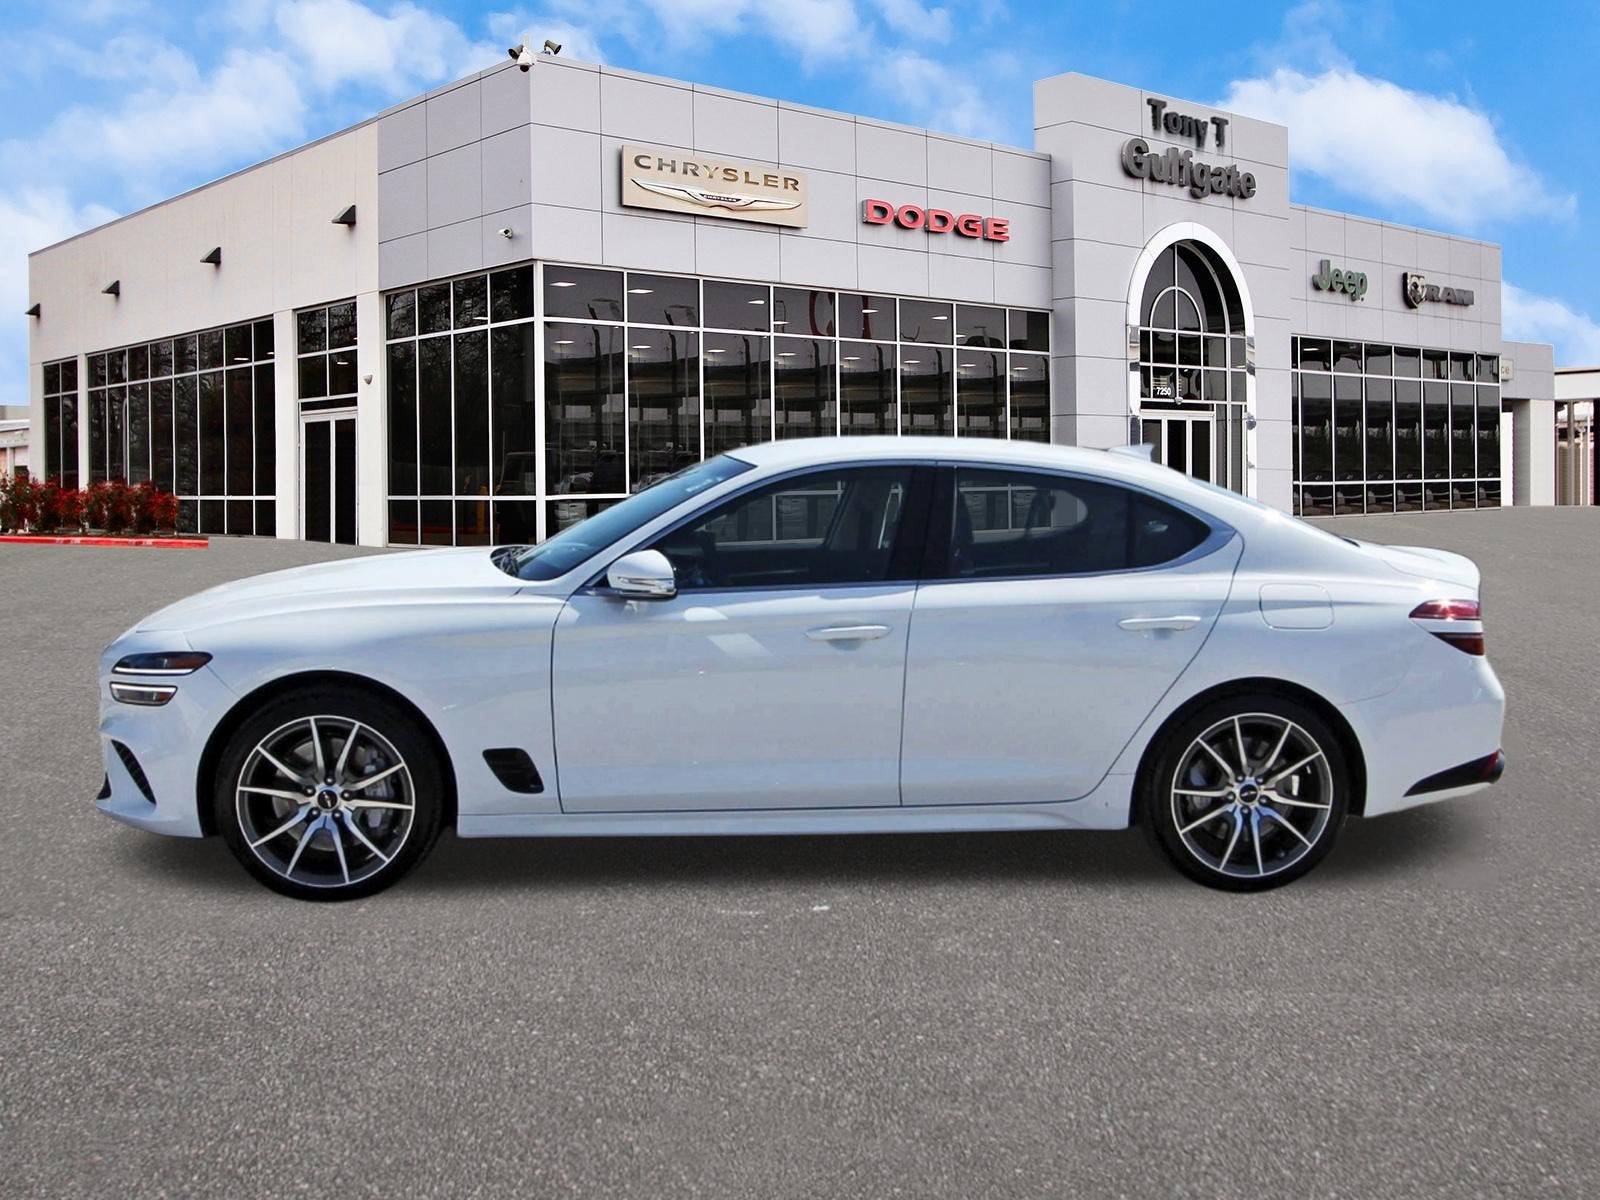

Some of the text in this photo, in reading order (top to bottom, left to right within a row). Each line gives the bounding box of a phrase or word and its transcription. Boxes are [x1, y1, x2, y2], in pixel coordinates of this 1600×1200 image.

[1147, 98, 1229, 148] Tony T
[634, 154, 800, 191] CHRYSLER
[1121, 138, 1256, 199] Gulfgate
[862, 199, 1010, 242] DODGE
[1312, 259, 1368, 302] Jeep
[1424, 283, 1475, 306] RAM
